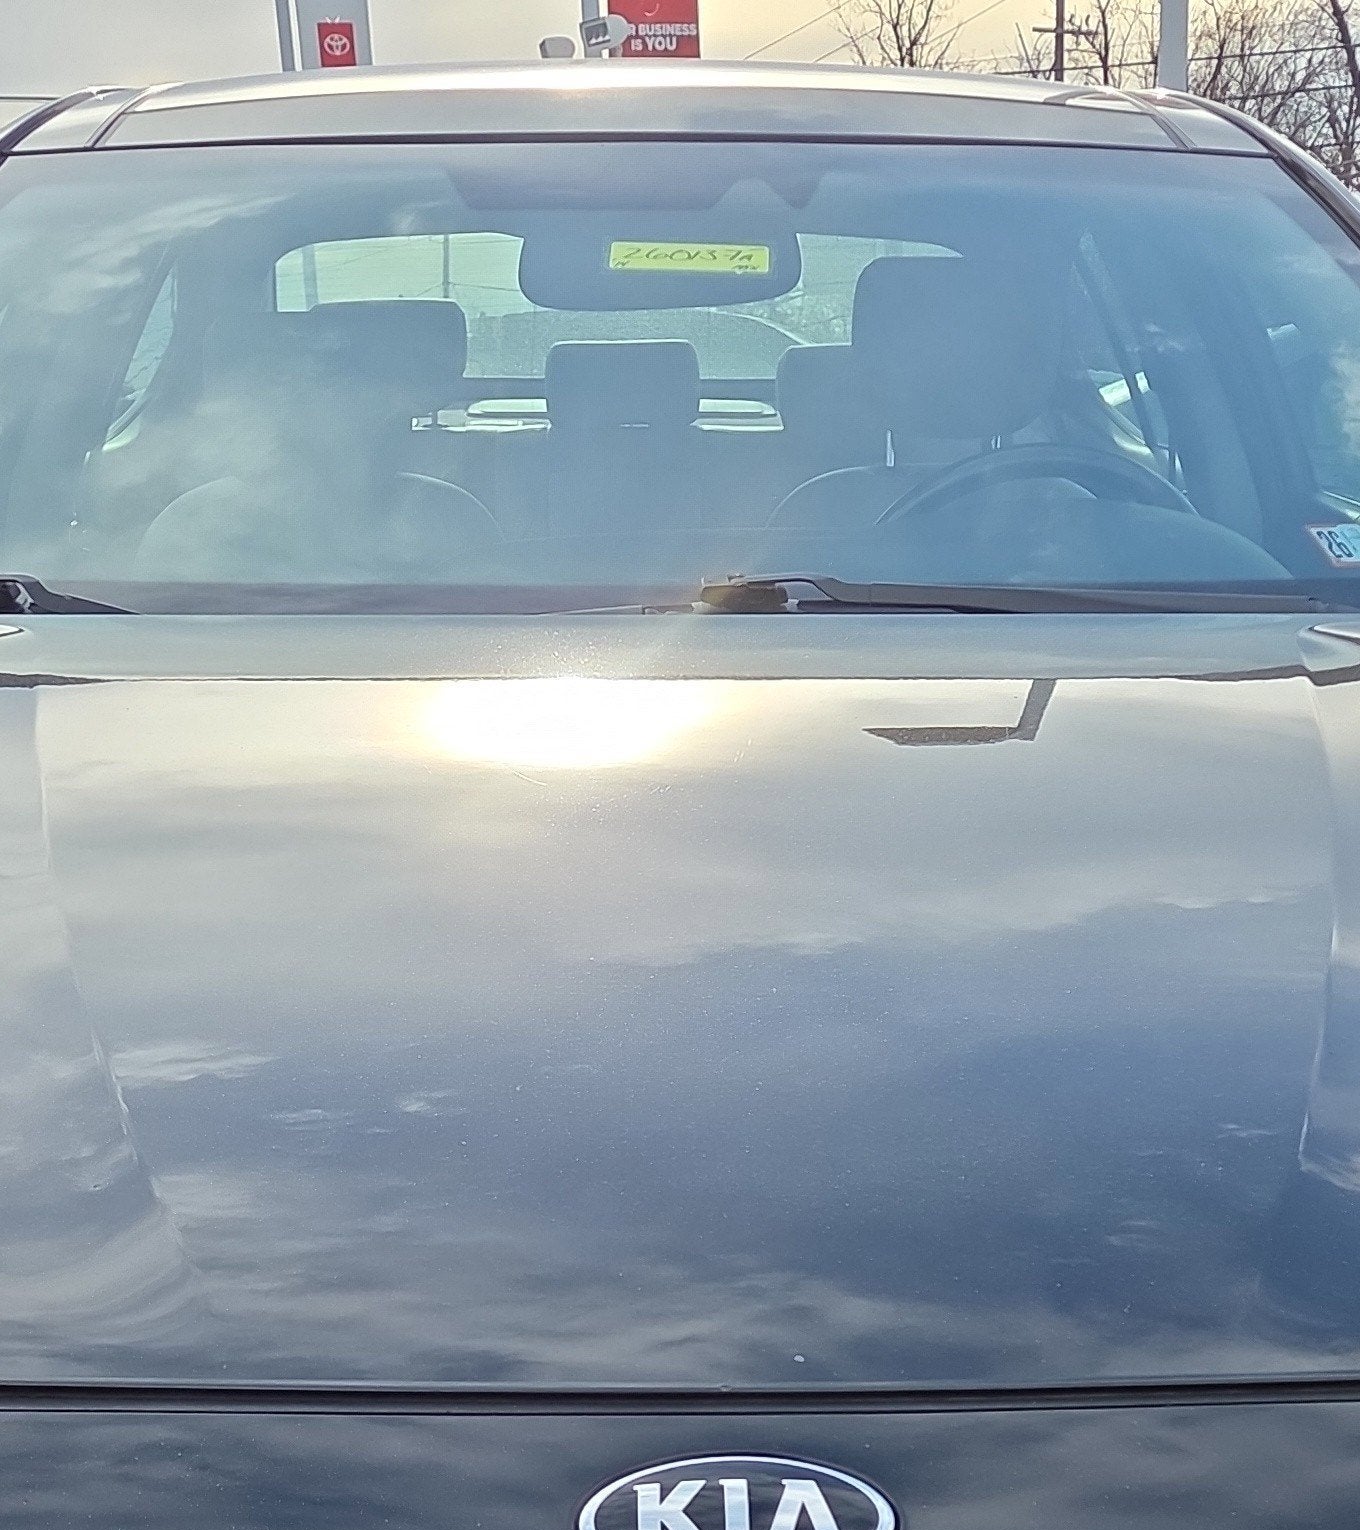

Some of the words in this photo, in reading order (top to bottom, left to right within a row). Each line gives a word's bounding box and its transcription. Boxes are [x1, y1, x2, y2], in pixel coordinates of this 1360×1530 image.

[638, 23, 697, 35] BUSINESS
[630, 38, 643, 51] IS
[644, 36, 677, 51] YOU
[1316, 531, 1354, 558] 26
